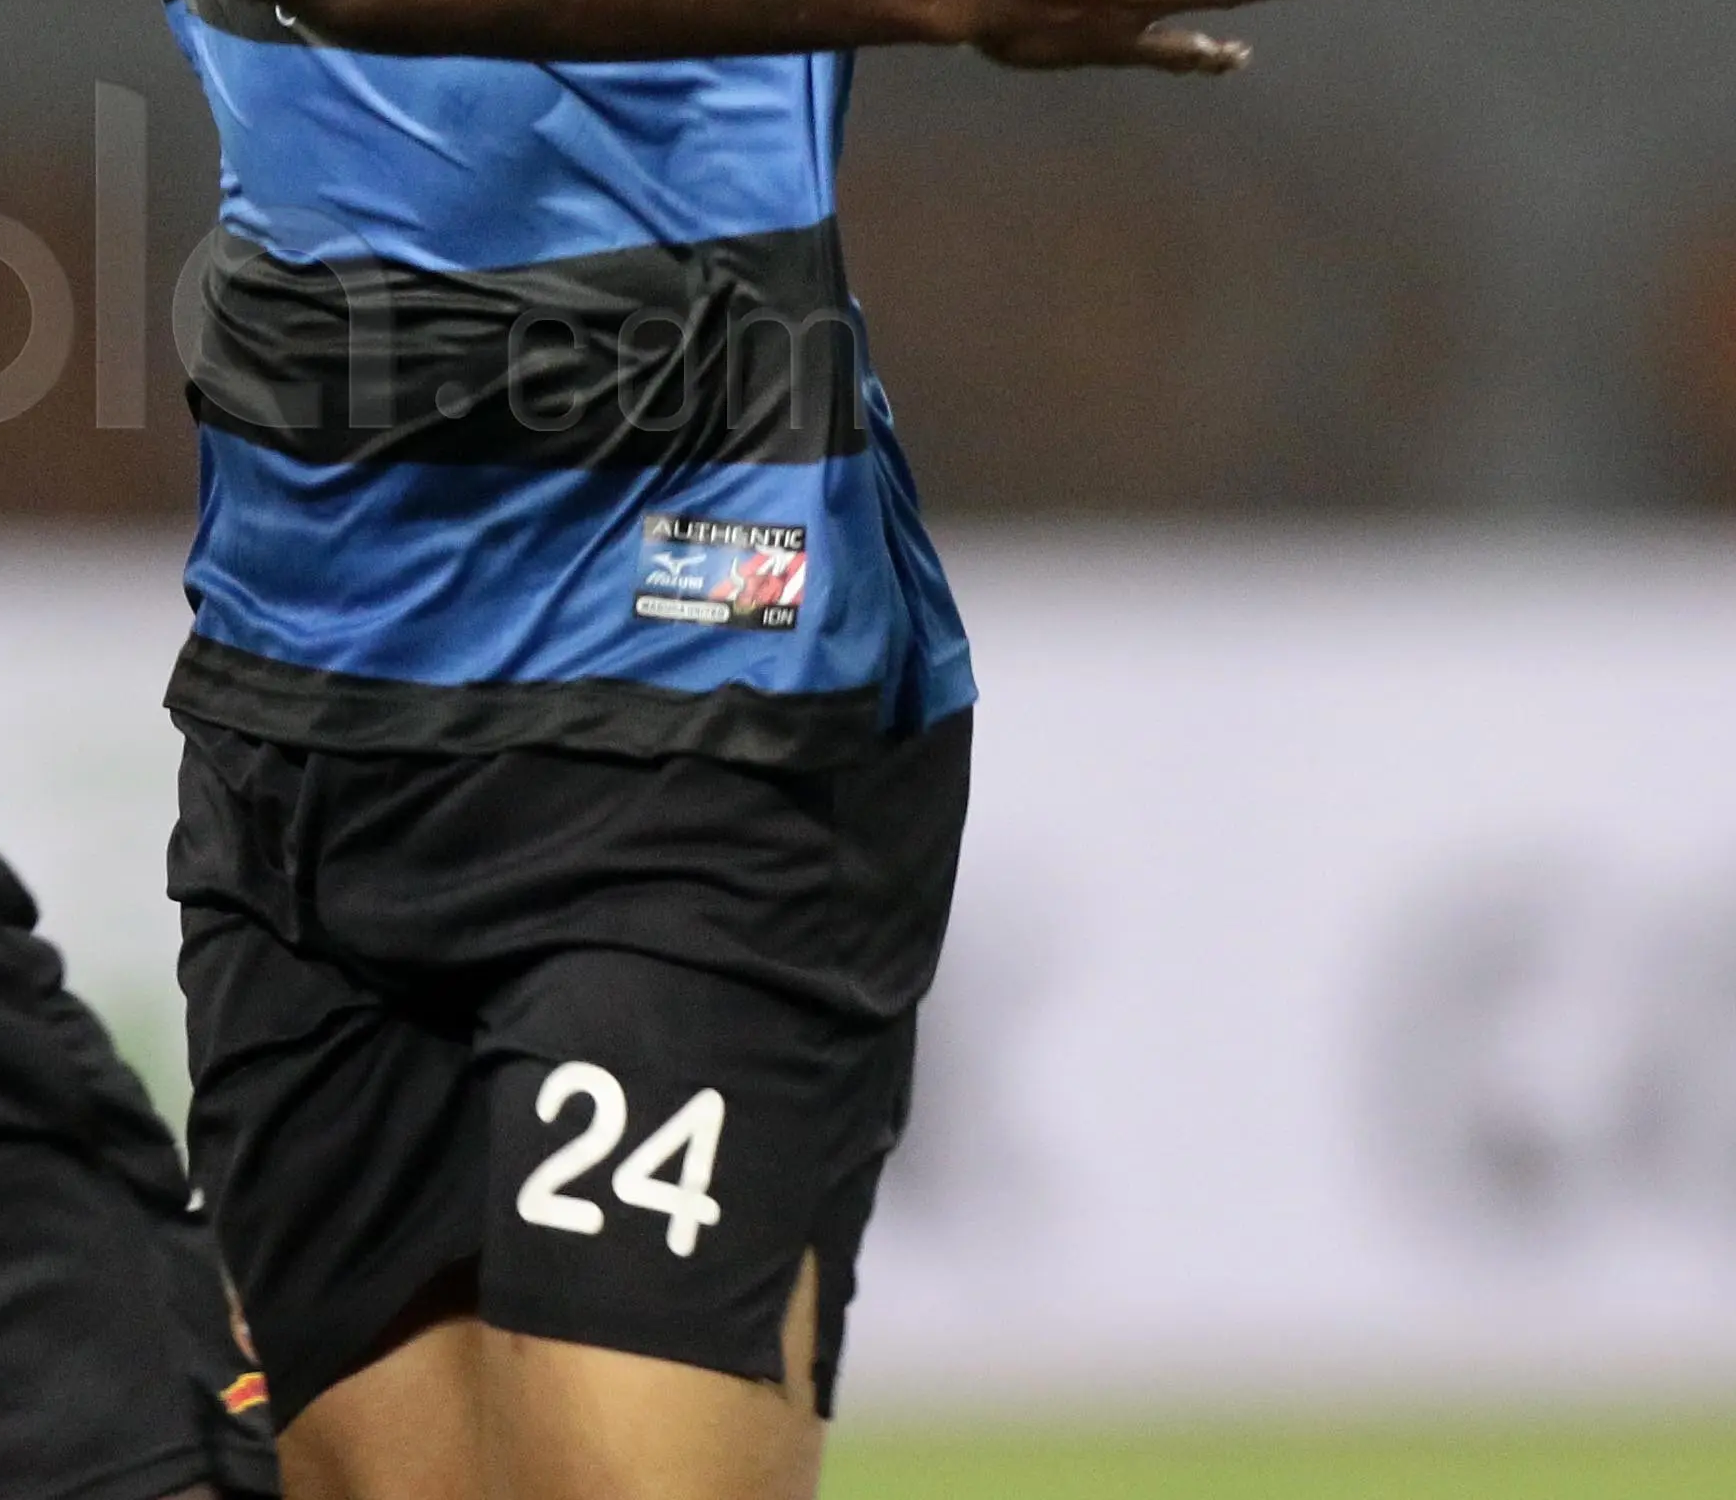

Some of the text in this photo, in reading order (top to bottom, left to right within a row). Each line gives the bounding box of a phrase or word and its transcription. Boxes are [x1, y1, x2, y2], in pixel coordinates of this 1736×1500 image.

[652, 518, 805, 550] AUTHENTIC
[762, 606, 795, 626] IDN
[516, 1060, 726, 1258] 24
